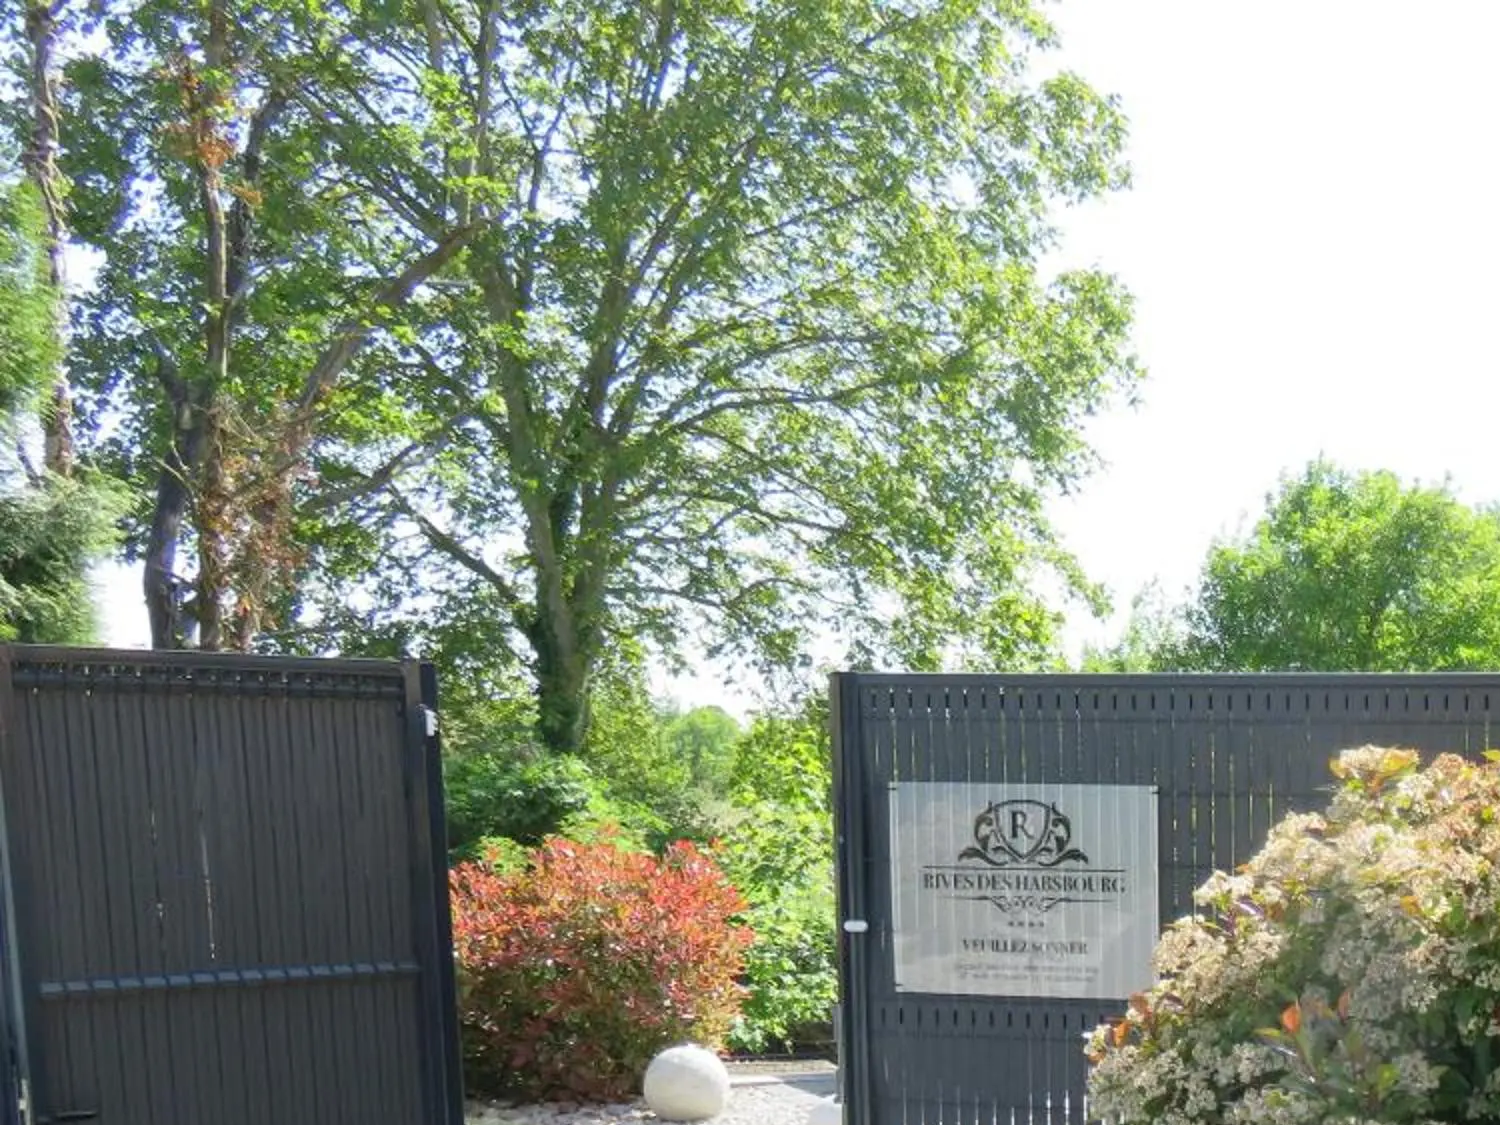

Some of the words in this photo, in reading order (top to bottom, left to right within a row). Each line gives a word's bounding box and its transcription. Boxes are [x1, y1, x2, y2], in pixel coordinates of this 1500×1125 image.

[1009, 810, 1034, 839] R
[923, 873, 974, 889] RIVES
[977, 874, 1012, 891] DES
[1015, 874, 1125, 893] HABSBOURG
[962, 938, 1026, 953] VEUILLEZ
[1031, 940, 1088, 955] SONNER
